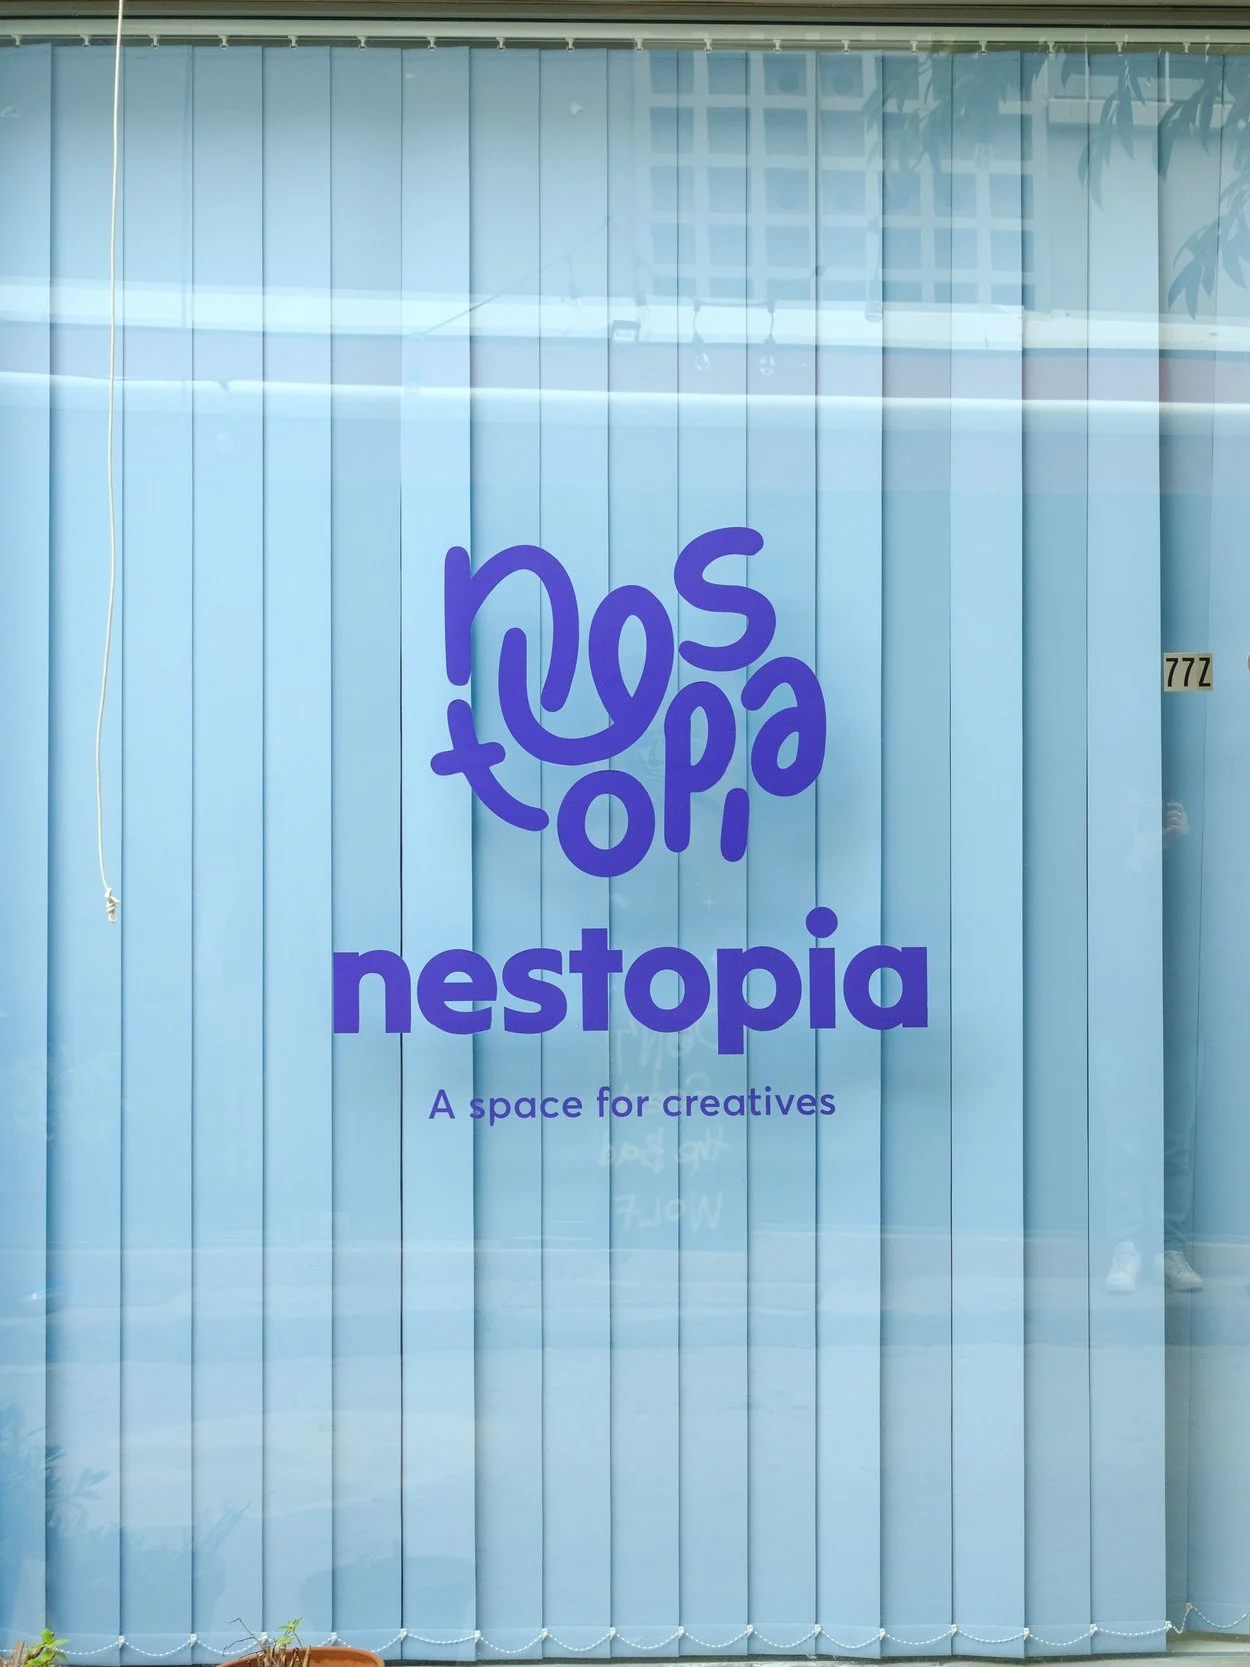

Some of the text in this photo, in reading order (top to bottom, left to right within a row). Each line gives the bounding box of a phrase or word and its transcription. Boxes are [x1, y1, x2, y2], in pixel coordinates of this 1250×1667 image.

[332, 906, 929, 1056] nestopia
[429, 1089, 455, 1120] A
[469, 1092, 583, 1127] space
[596, 1086, 650, 1118] for
[662, 1086, 837, 1118] creatives
